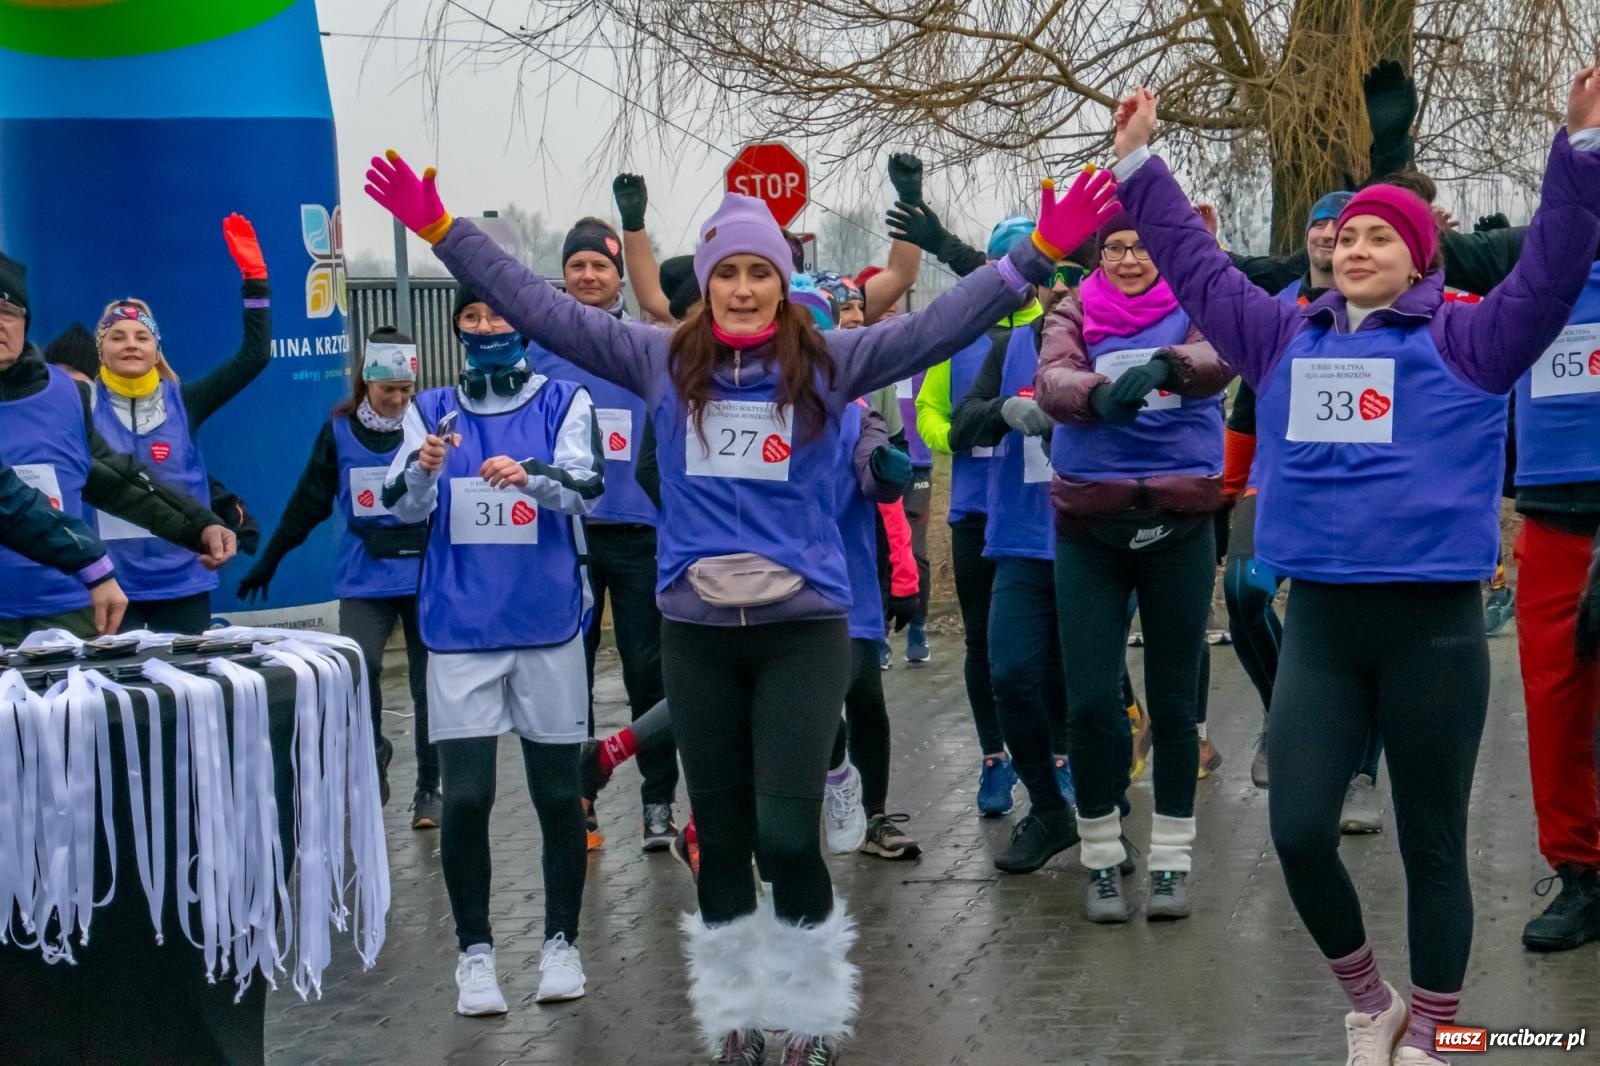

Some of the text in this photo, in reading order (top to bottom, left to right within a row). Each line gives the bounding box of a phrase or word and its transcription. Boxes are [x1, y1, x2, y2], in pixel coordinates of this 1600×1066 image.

[734, 172, 800, 199] STOP
[315, 330, 350, 356] KRZYŻ
[1336, 371, 1372, 379] ROSZKÓW
[1552, 351, 1584, 378] 65
[1316, 390, 1354, 421] 33
[719, 428, 758, 457] 27
[475, 501, 507, 527] 31
[1135, 525, 1164, 541] NIKE
